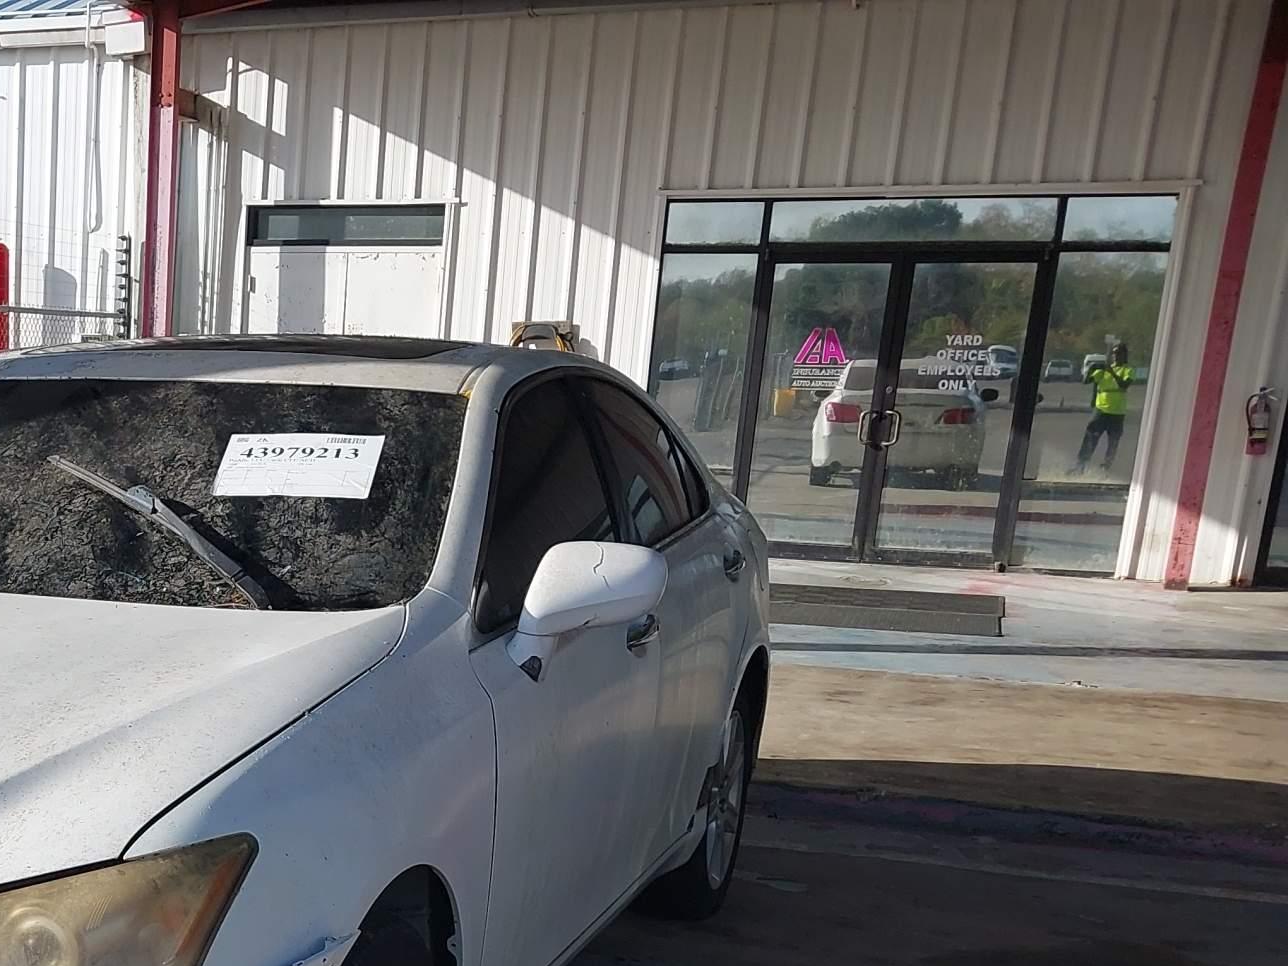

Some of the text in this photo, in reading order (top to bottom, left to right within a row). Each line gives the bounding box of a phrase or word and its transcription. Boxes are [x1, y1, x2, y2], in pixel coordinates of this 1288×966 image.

[945, 335, 983, 346] YARD
[936, 349, 987, 361] OFFICE
[792, 368, 845, 376] INSURANC
[917, 364, 1001, 376] EMPLOYEES
[938, 379, 976, 391] ONLY
[239, 446, 360, 460] 43979213
